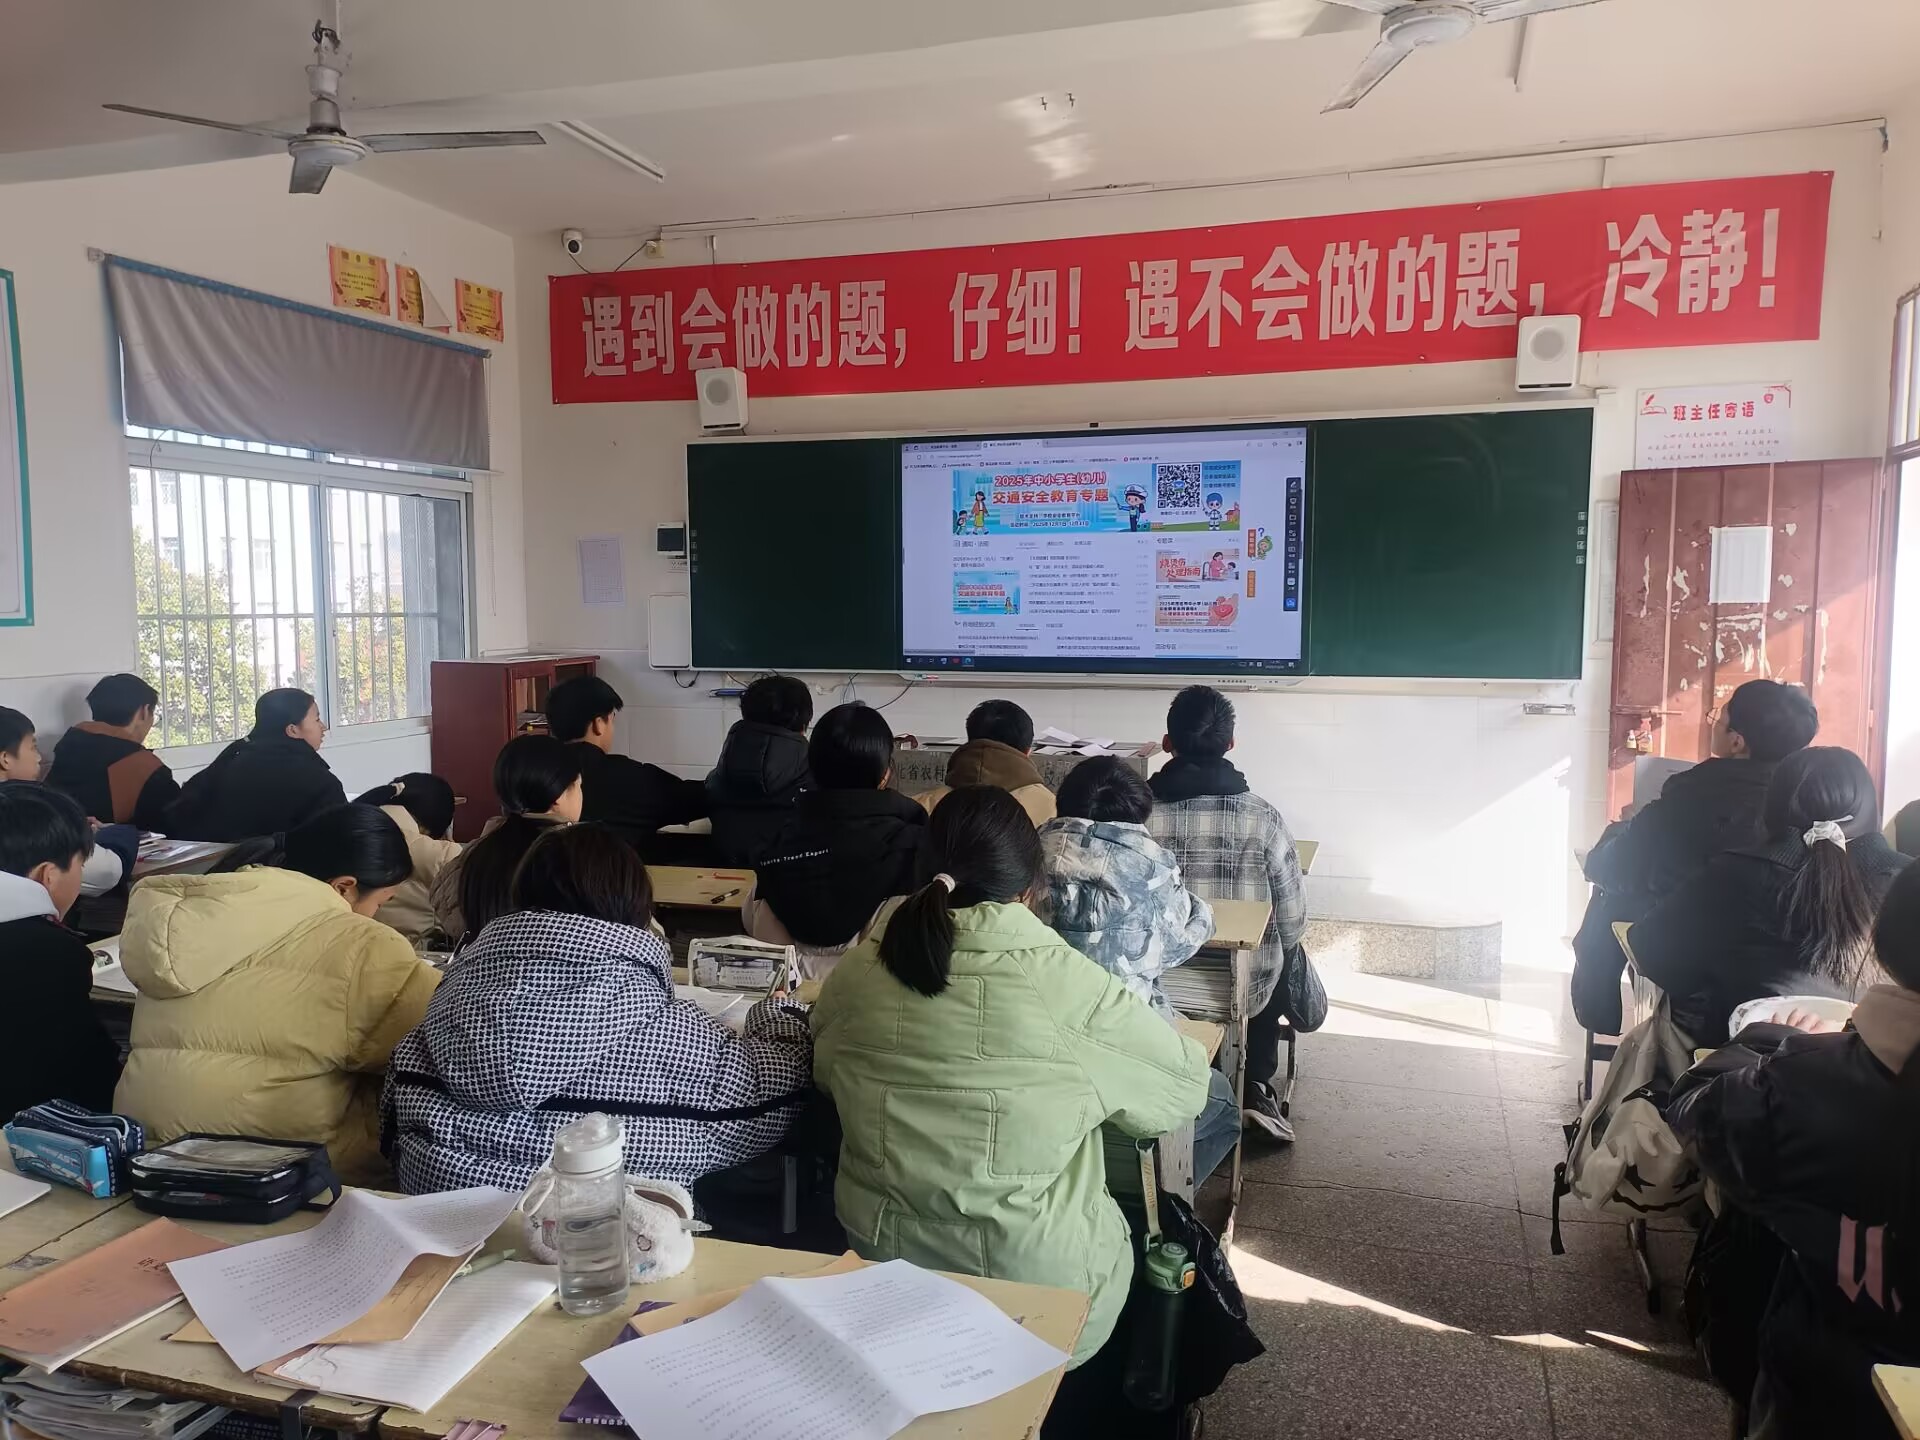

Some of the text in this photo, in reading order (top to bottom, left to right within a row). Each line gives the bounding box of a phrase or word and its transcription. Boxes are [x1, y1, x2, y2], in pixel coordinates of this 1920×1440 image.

[1673, 401, 1755, 421] 班主任寄语
[992, 488, 1109, 504] 交通安全教育专题
[1165, 566, 1201, 578] 处理指南
